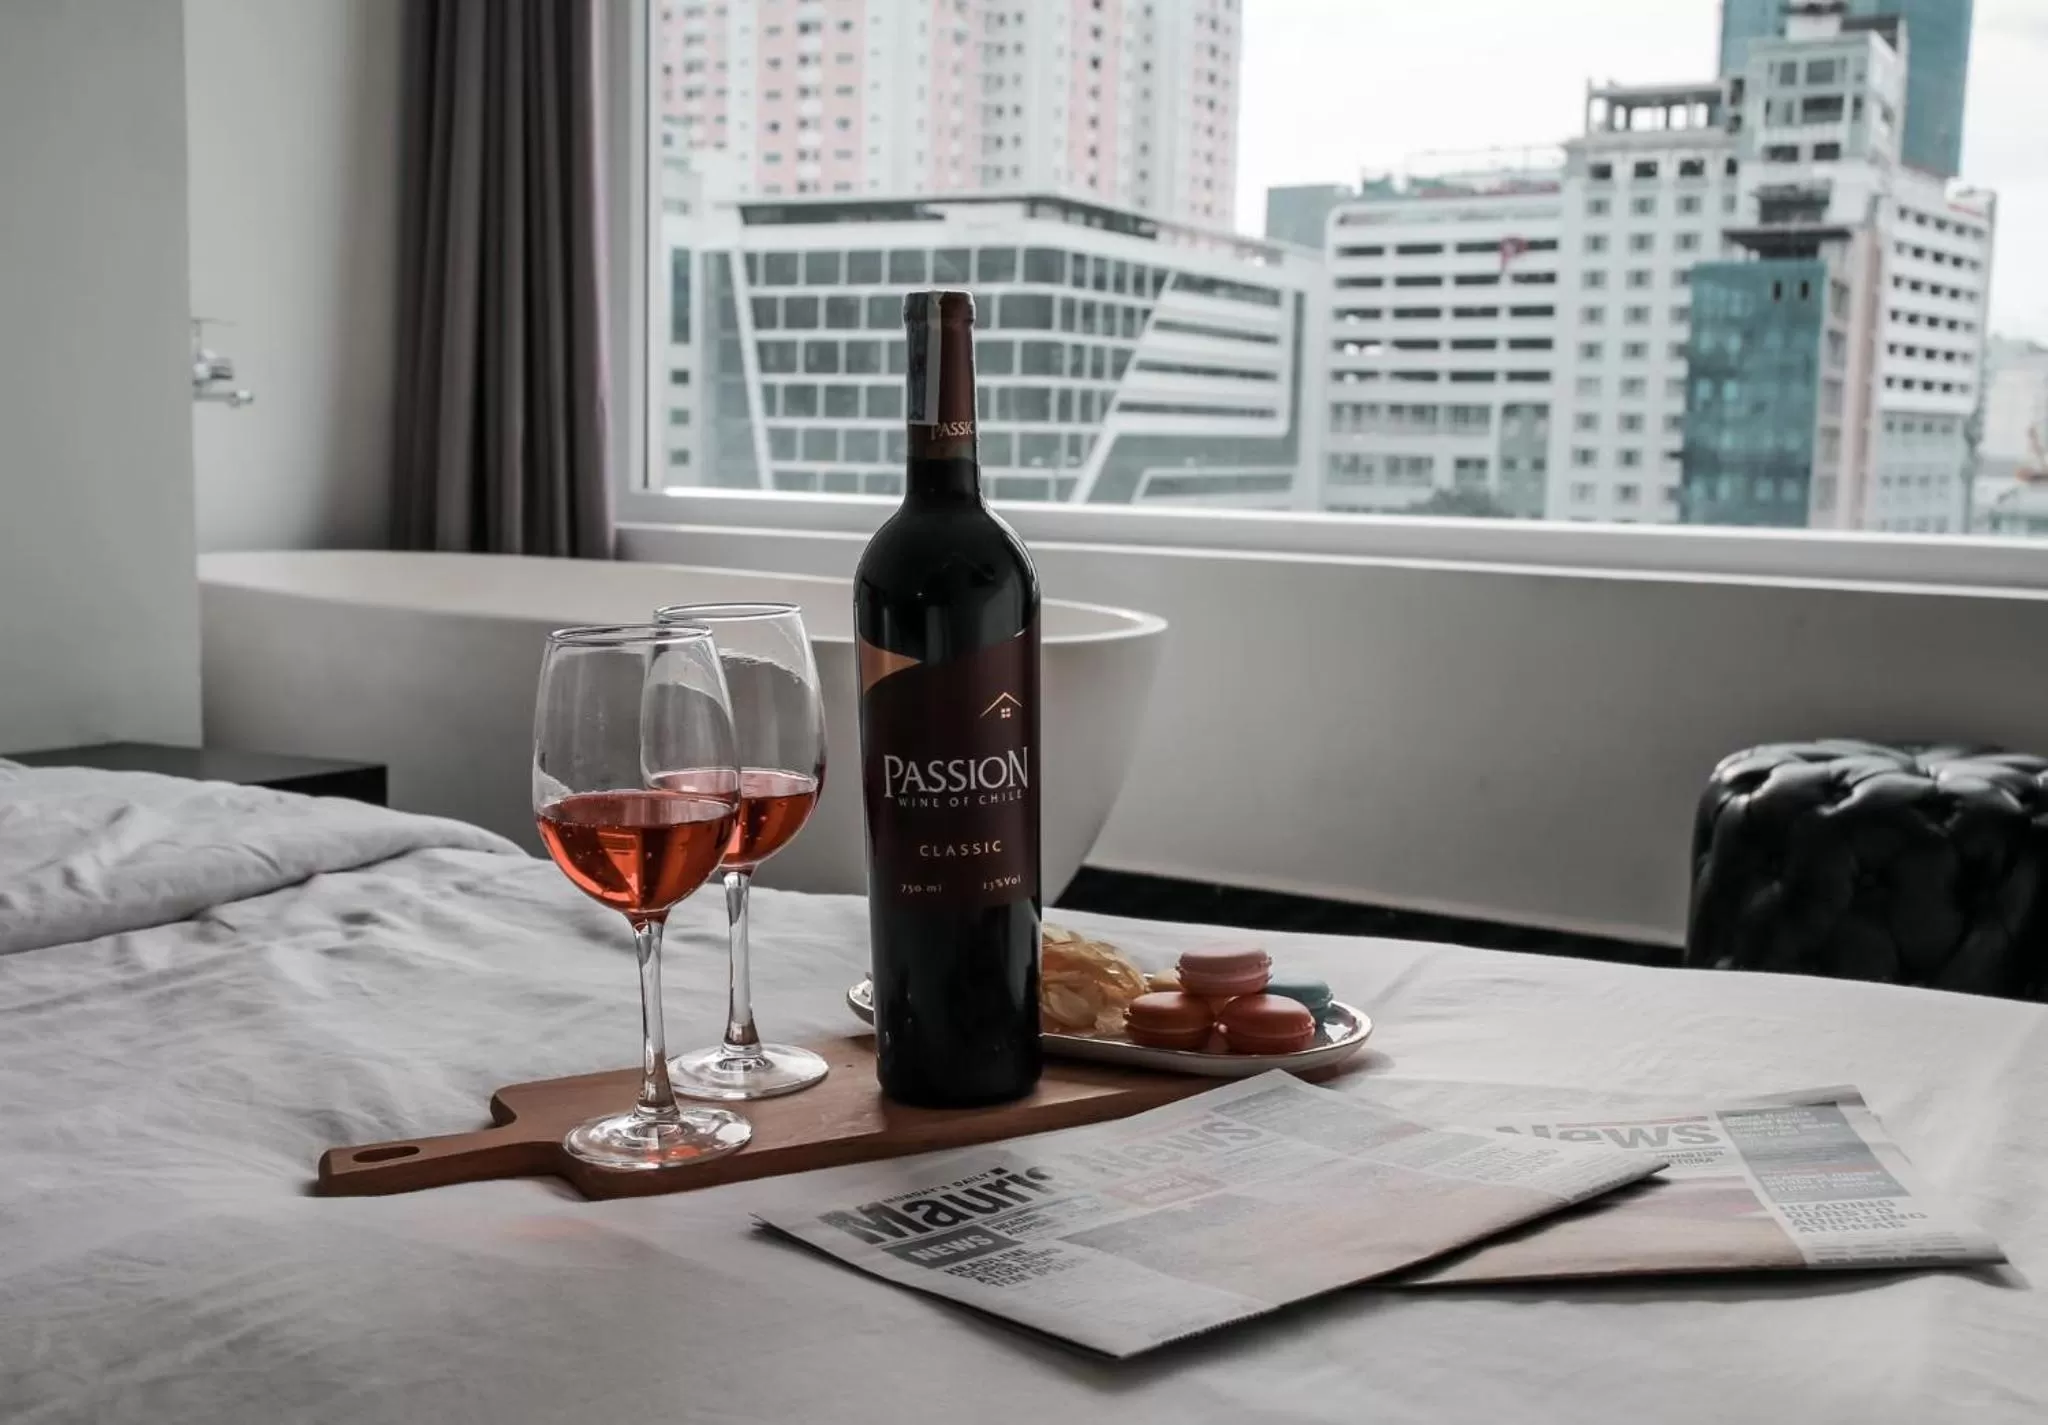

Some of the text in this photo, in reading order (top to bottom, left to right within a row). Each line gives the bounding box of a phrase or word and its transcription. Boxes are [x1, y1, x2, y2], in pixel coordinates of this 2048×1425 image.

[884, 746, 1028, 798] PASSION
[898, 789, 1023, 808] WINE OF CHILE
[919, 840, 1002, 857] CLASSIC
[901, 883, 922, 894] 750
[926, 883, 942, 893] ml
[908, 1234, 995, 1261] NEWS
